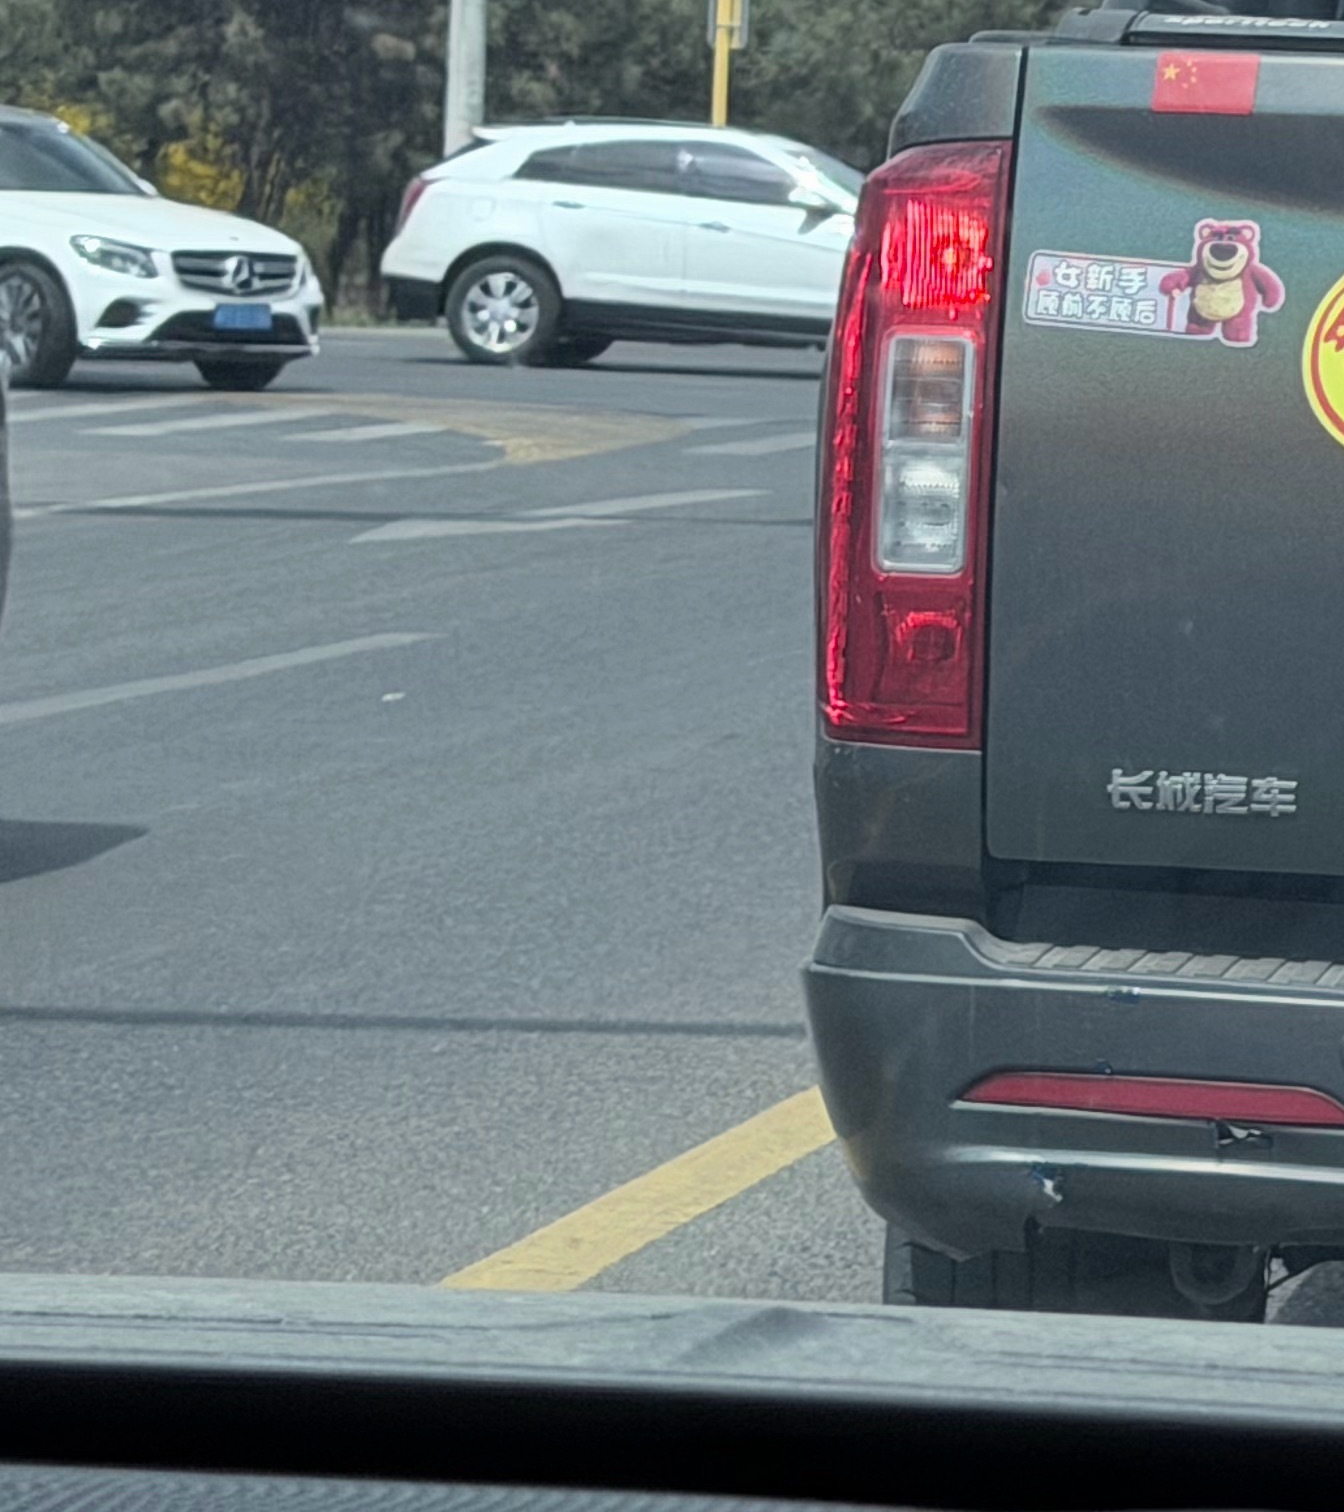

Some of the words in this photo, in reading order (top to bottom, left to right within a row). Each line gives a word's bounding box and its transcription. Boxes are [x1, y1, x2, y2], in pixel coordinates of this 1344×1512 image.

[1054, 260, 1148, 295] 女新手
[1036, 289, 1157, 325] 顾前不顾后
[1106, 768, 1298, 818] 长城汽车
